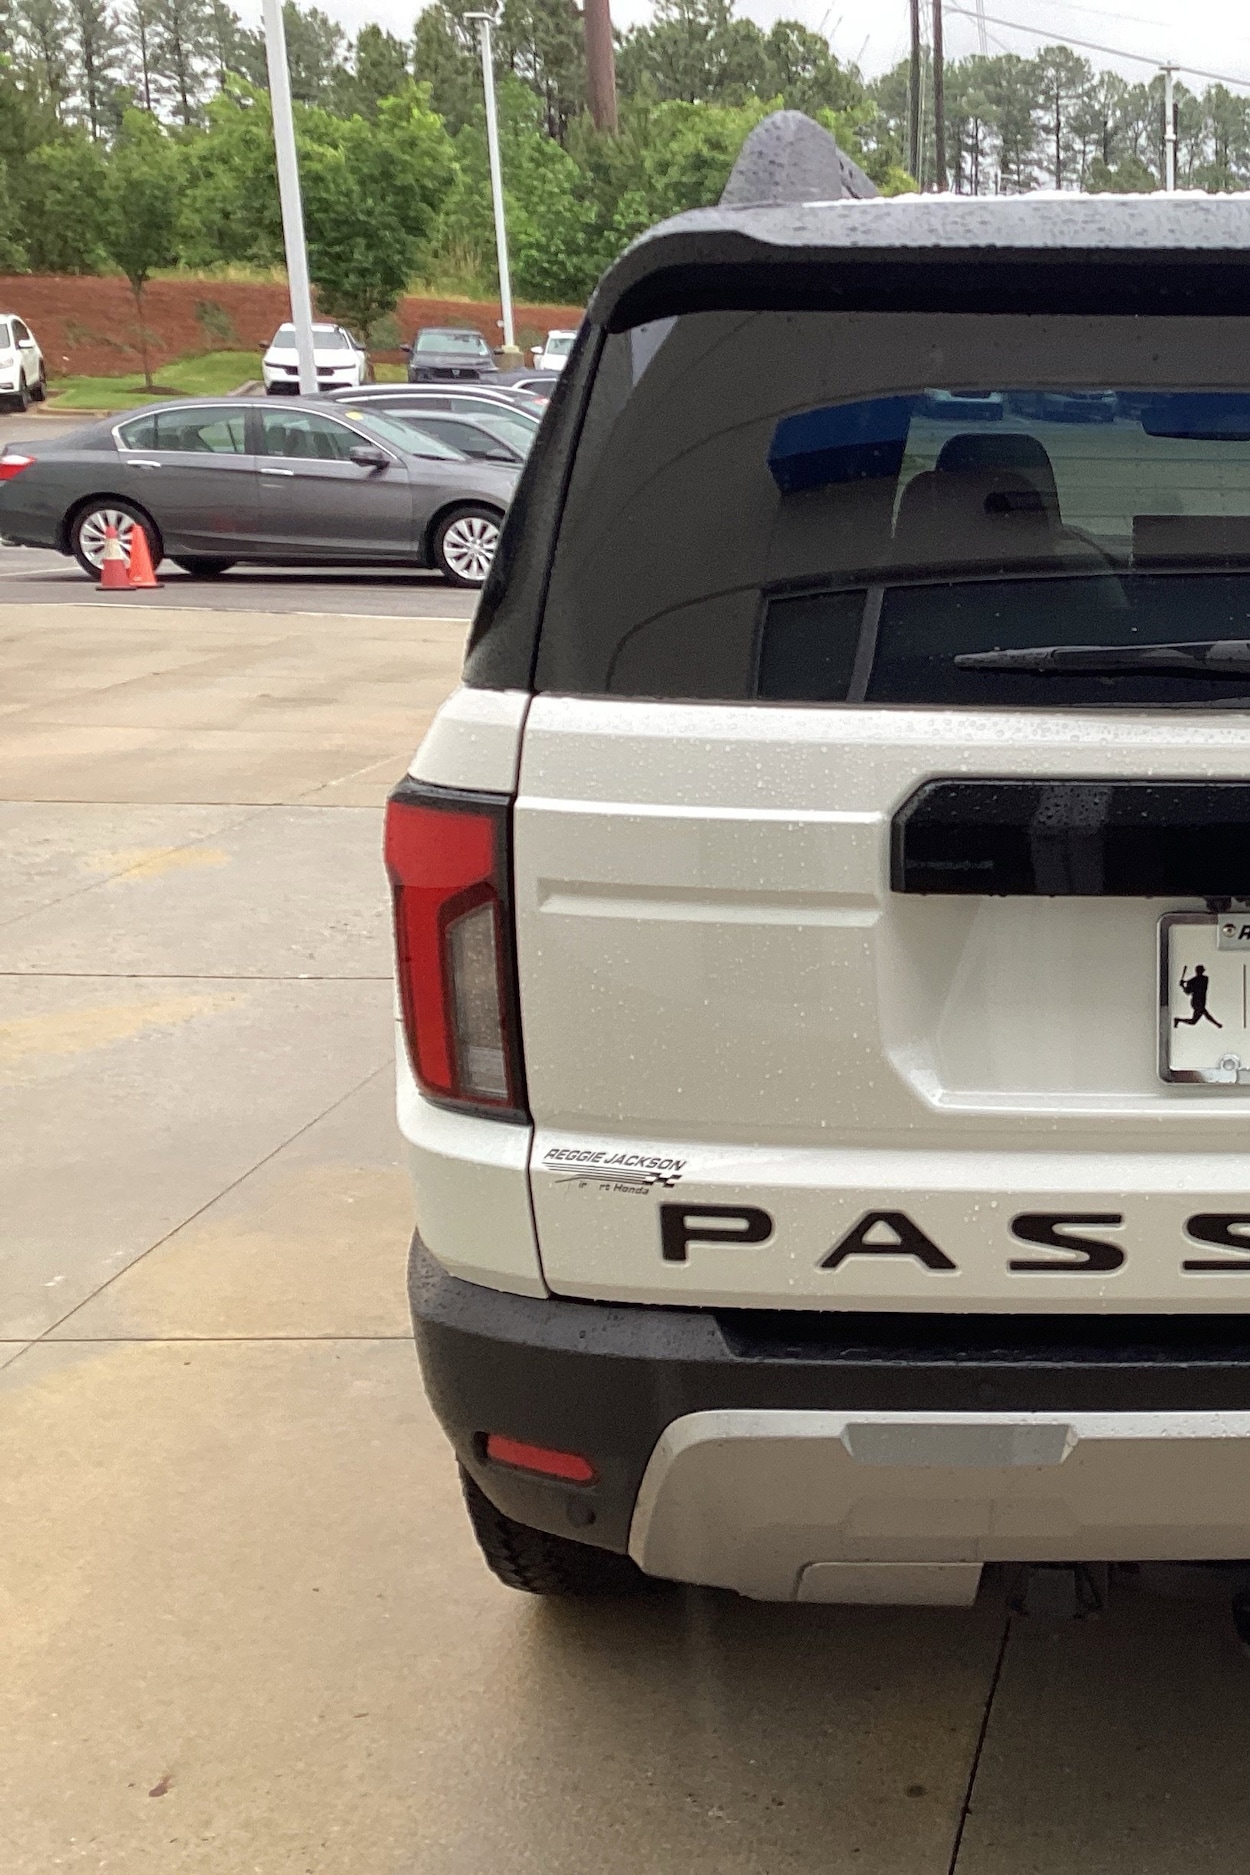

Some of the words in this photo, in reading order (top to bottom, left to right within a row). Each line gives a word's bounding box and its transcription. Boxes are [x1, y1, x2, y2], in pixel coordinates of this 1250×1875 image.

[544, 1148, 607, 1163] REGGIE
[603, 1153, 688, 1171] JACKSON
[613, 1183, 650, 1195] Honda
